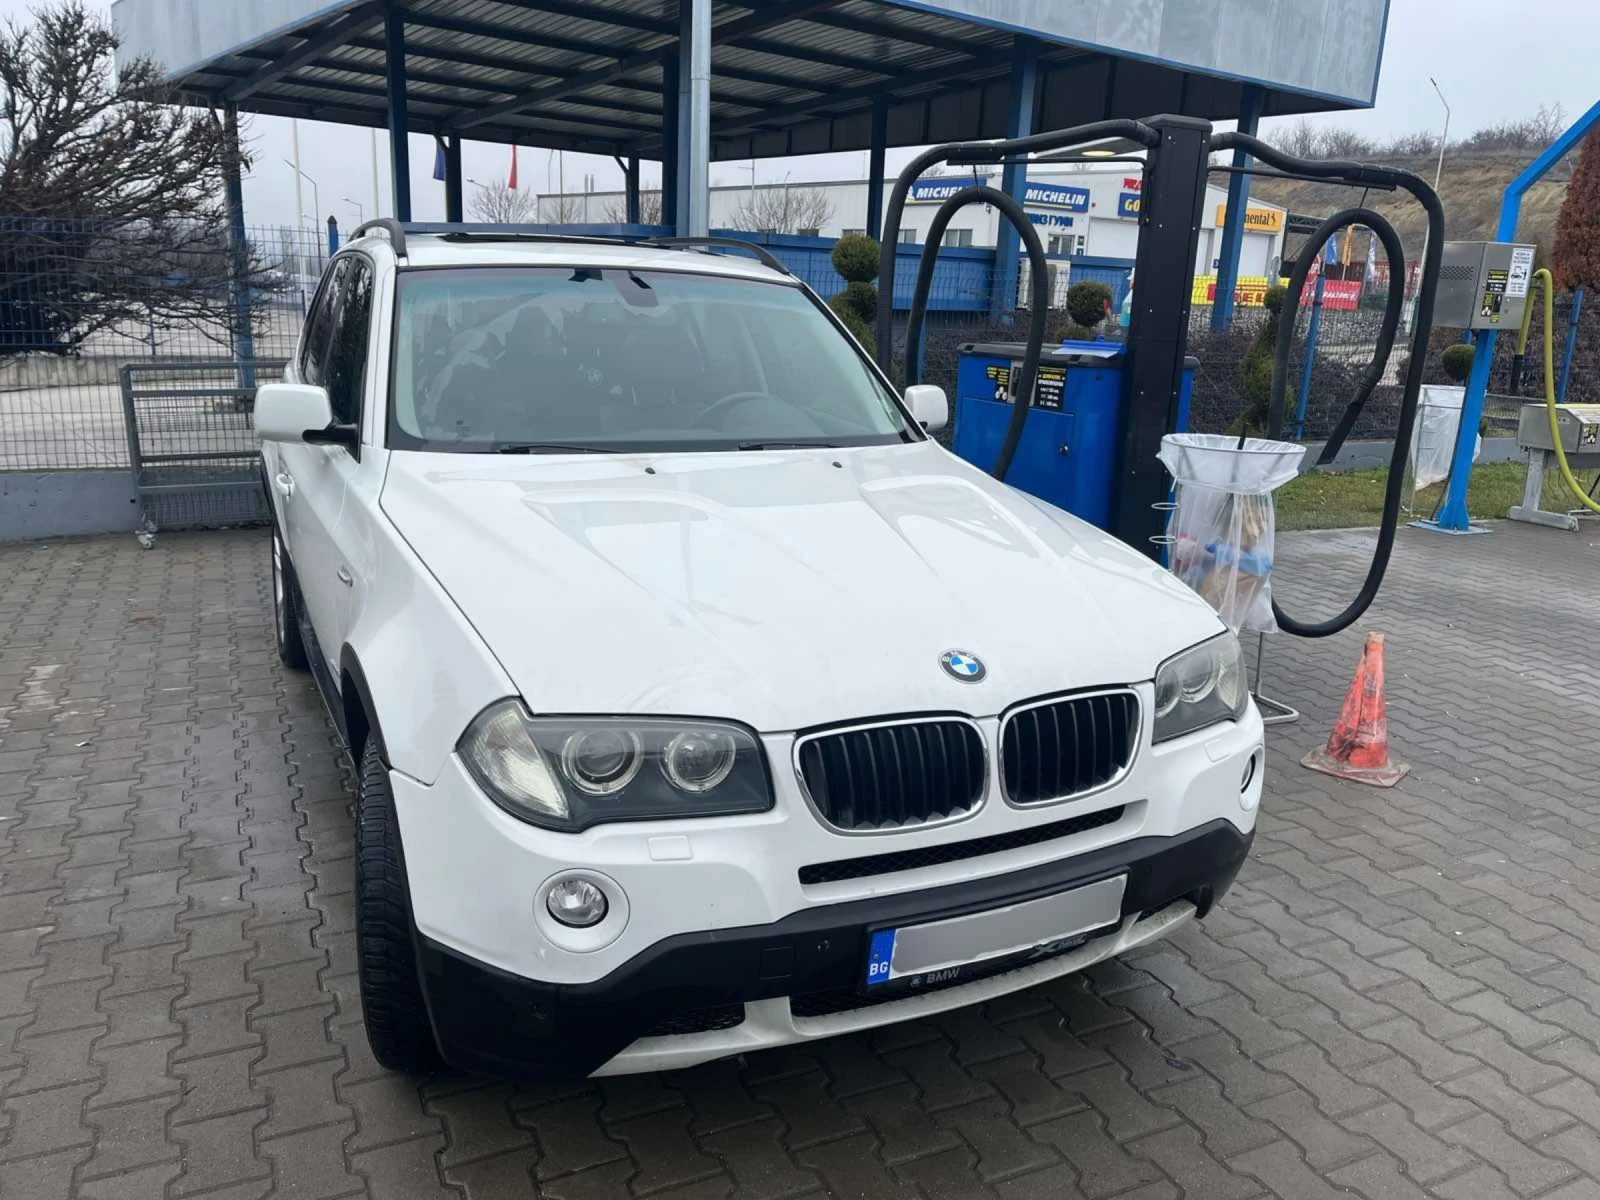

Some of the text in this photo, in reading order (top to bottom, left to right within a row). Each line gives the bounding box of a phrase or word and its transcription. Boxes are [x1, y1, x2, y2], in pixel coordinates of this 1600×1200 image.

[916, 186, 963, 199] MICHE
[1025, 188, 1086, 206] MICHELIN
[869, 961, 889, 977] BG
[926, 967, 960, 984] BMW
